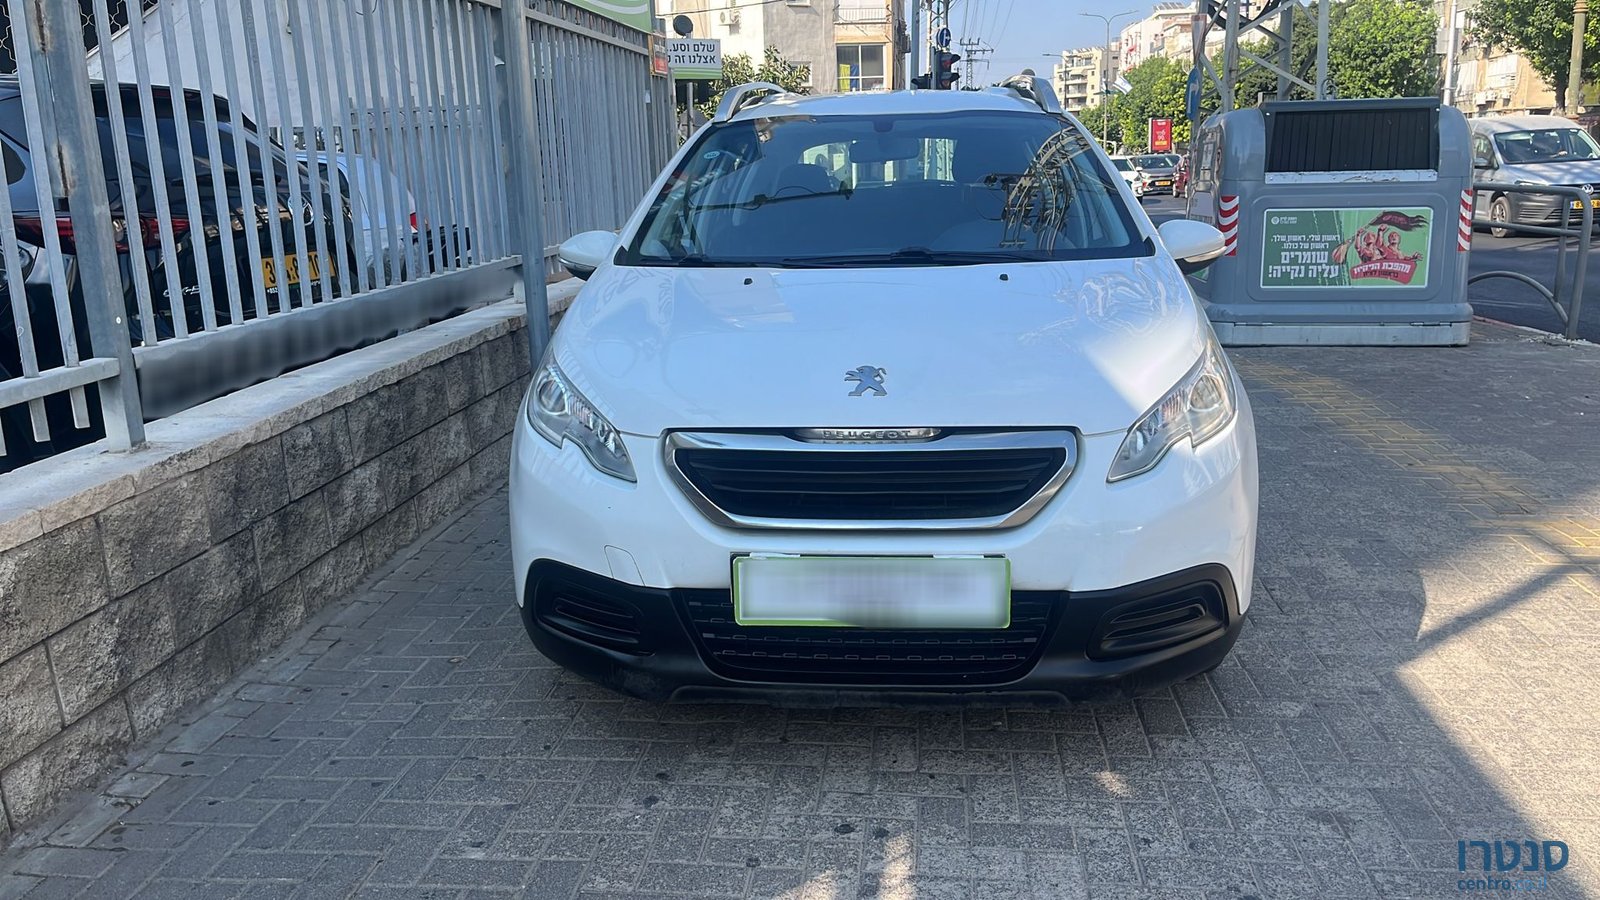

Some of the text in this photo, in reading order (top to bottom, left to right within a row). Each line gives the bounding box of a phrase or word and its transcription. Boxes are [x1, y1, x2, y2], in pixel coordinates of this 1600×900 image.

[693, 42, 715, 52] שלם
[675, 54, 685, 64] זה
[689, 53, 716, 64] אצלנו
[1322, 234, 1341, 242] ראשון
[1311, 242, 1329, 250] ראשון
[1281, 251, 1329, 264] שומרים
[1268, 264, 1339, 279] עליה נקייה!
[822, 430, 911, 439] PEUGEOT
